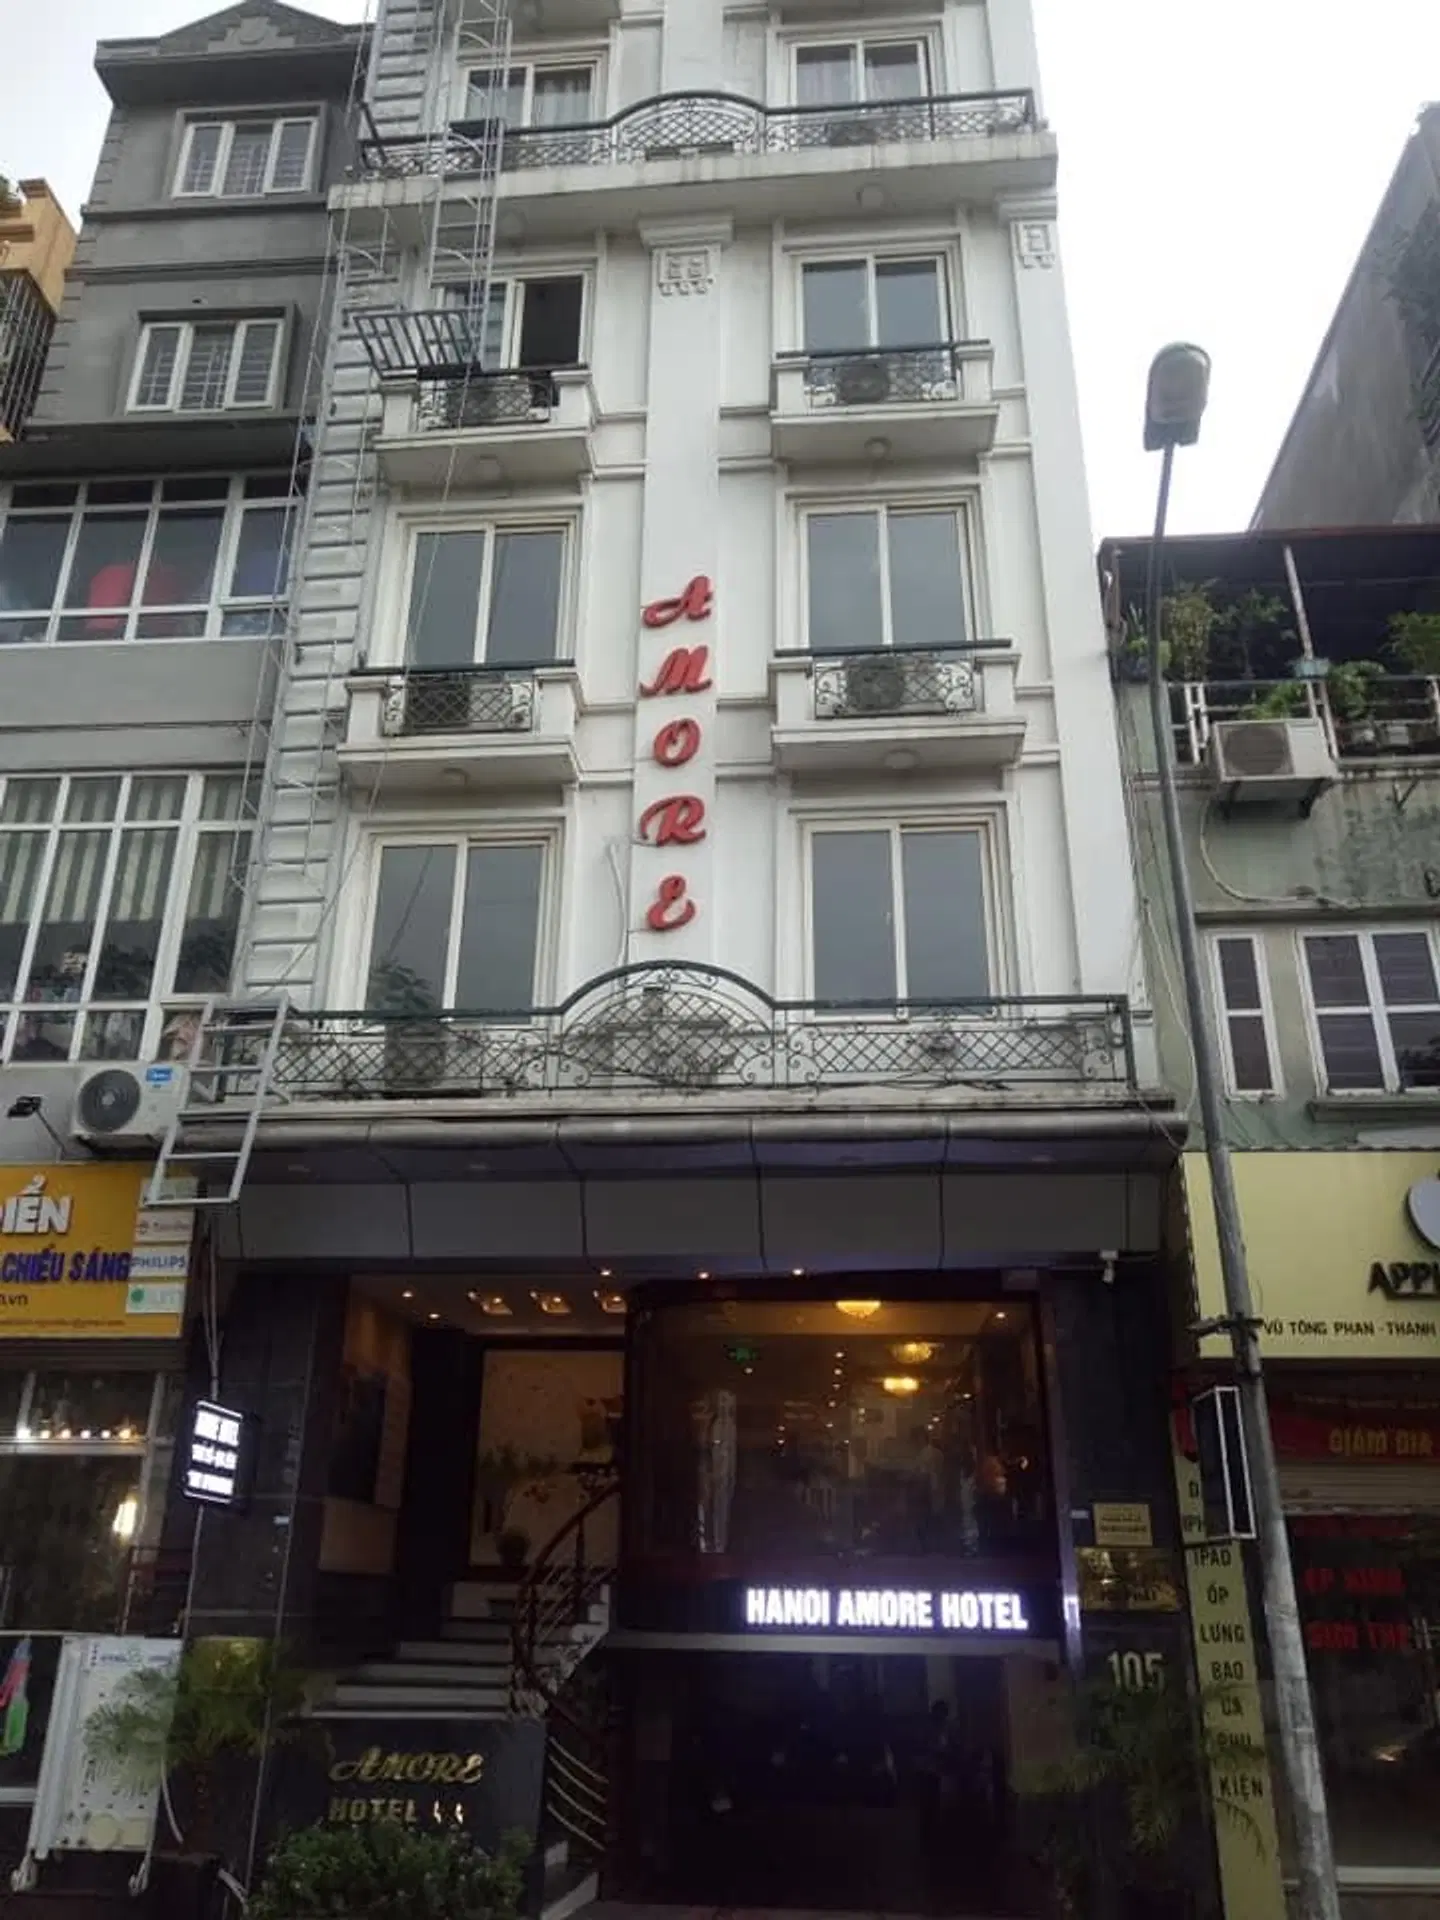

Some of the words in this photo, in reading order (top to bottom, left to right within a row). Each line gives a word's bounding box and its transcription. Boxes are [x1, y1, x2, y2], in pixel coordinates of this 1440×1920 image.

[640, 575, 713, 933] AMORE
[0, 1174, 71, 1235] IỂN
[69, 1246, 131, 1283] SÁNG
[132, 1254, 186, 1268] PHILIPS
[1194, 1548, 1231, 1567] IPAD
[747, 1587, 830, 1626] HANOI
[837, 1590, 934, 1628] AMORE
[940, 1592, 1028, 1630] HOTEL
[1107, 1650, 1166, 1690] 105
[1210, 1660, 1244, 1681] BAO
[328, 1797, 419, 1823] HOTEL
